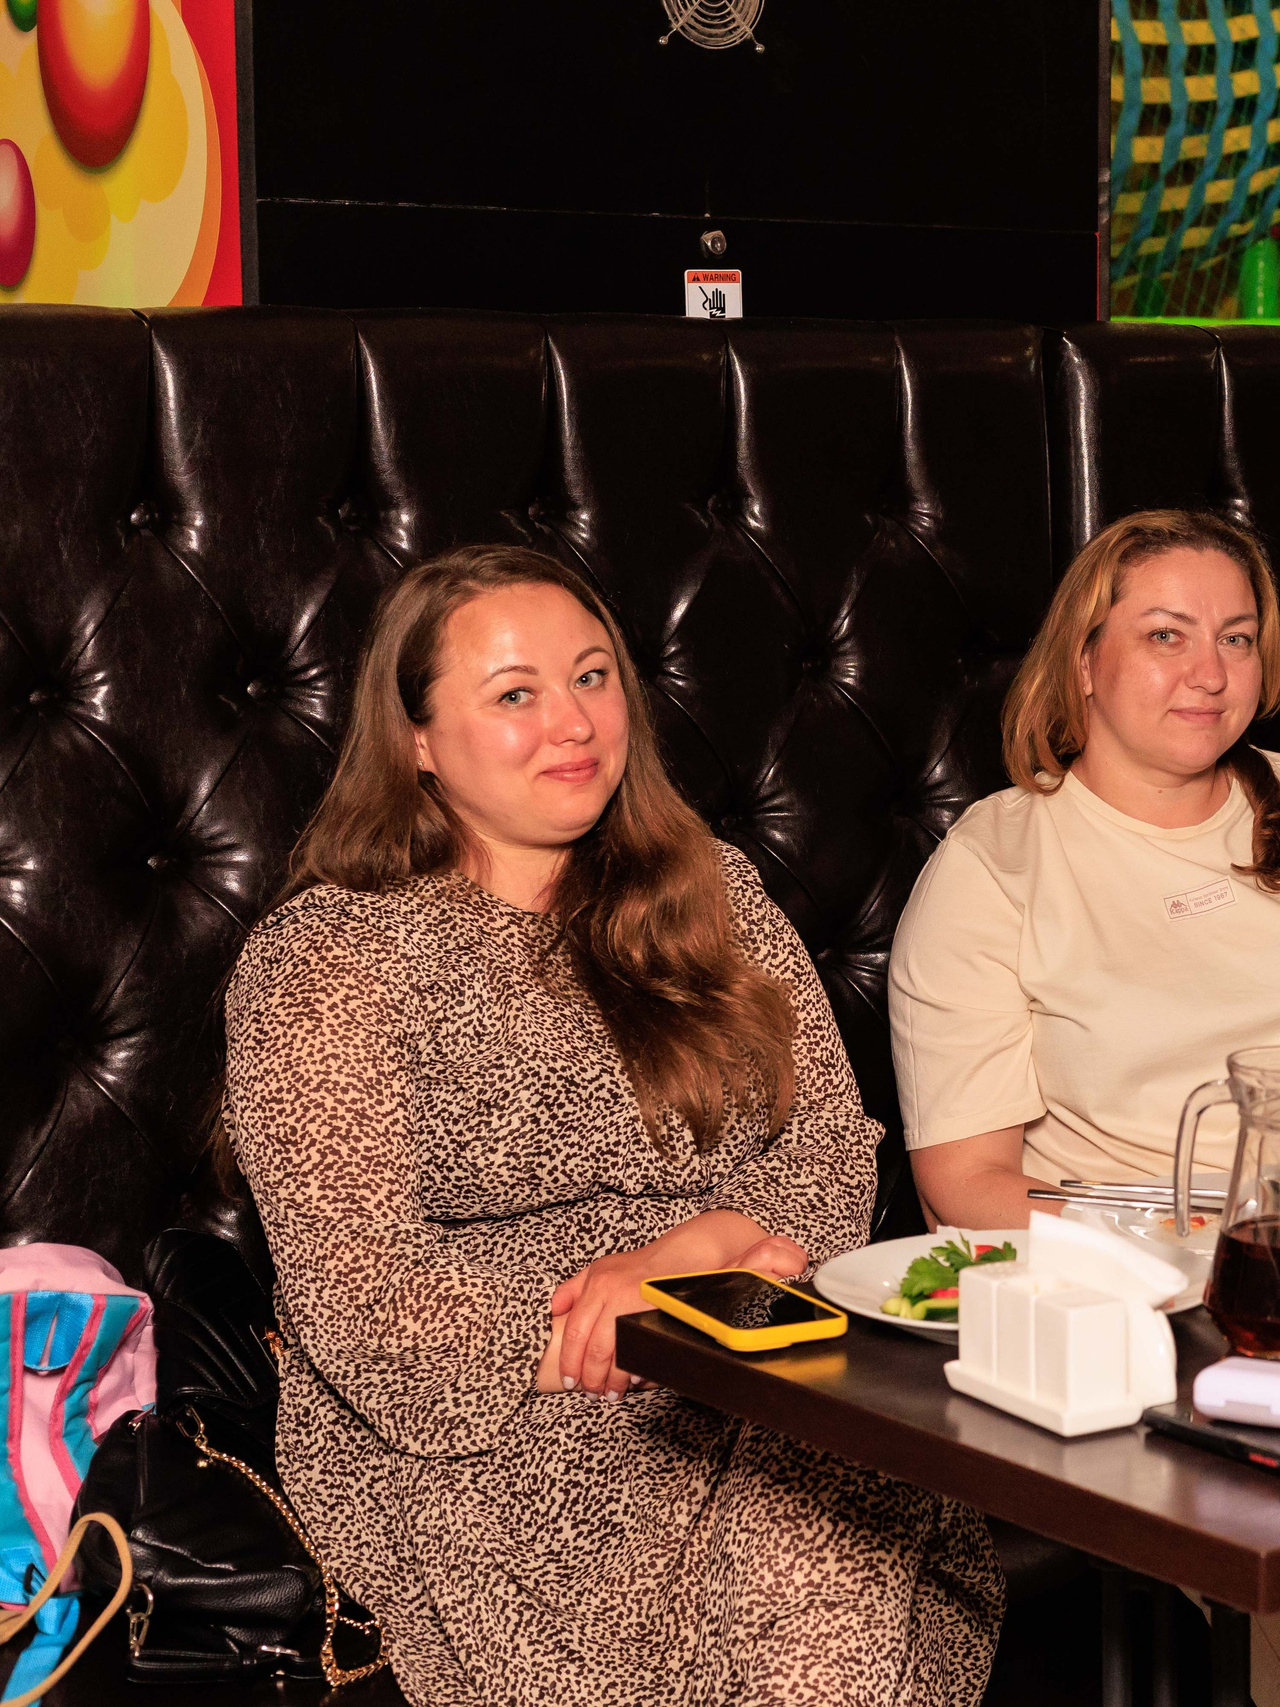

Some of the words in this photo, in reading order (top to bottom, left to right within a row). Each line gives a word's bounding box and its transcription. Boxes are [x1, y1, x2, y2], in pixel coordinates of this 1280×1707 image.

[702, 273, 737, 282] WARNING
[1193, 897, 1213, 908] SINCE
[1170, 906, 1189, 915] Kappa
